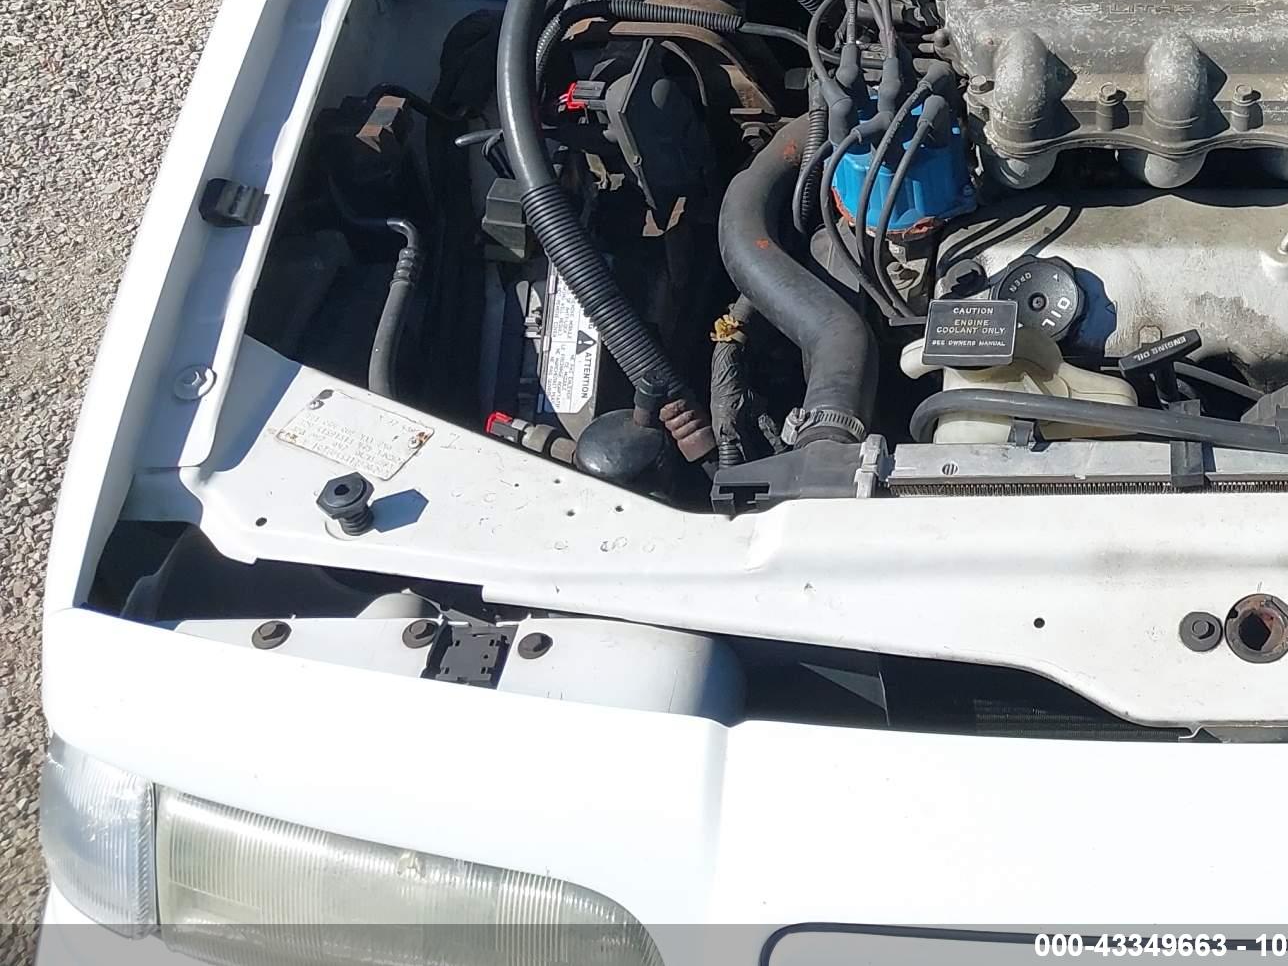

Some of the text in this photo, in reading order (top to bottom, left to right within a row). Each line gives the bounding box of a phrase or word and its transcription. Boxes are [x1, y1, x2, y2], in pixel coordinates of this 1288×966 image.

[1009, 272, 1032, 292] OPEN
[953, 307, 994, 315] CAUTION
[1041, 297, 1071, 327] OIL
[936, 326, 978, 334] COOLANT
[1133, 336, 1186, 362] ENGINE OIL
[581, 352, 593, 399] ATTENTION
